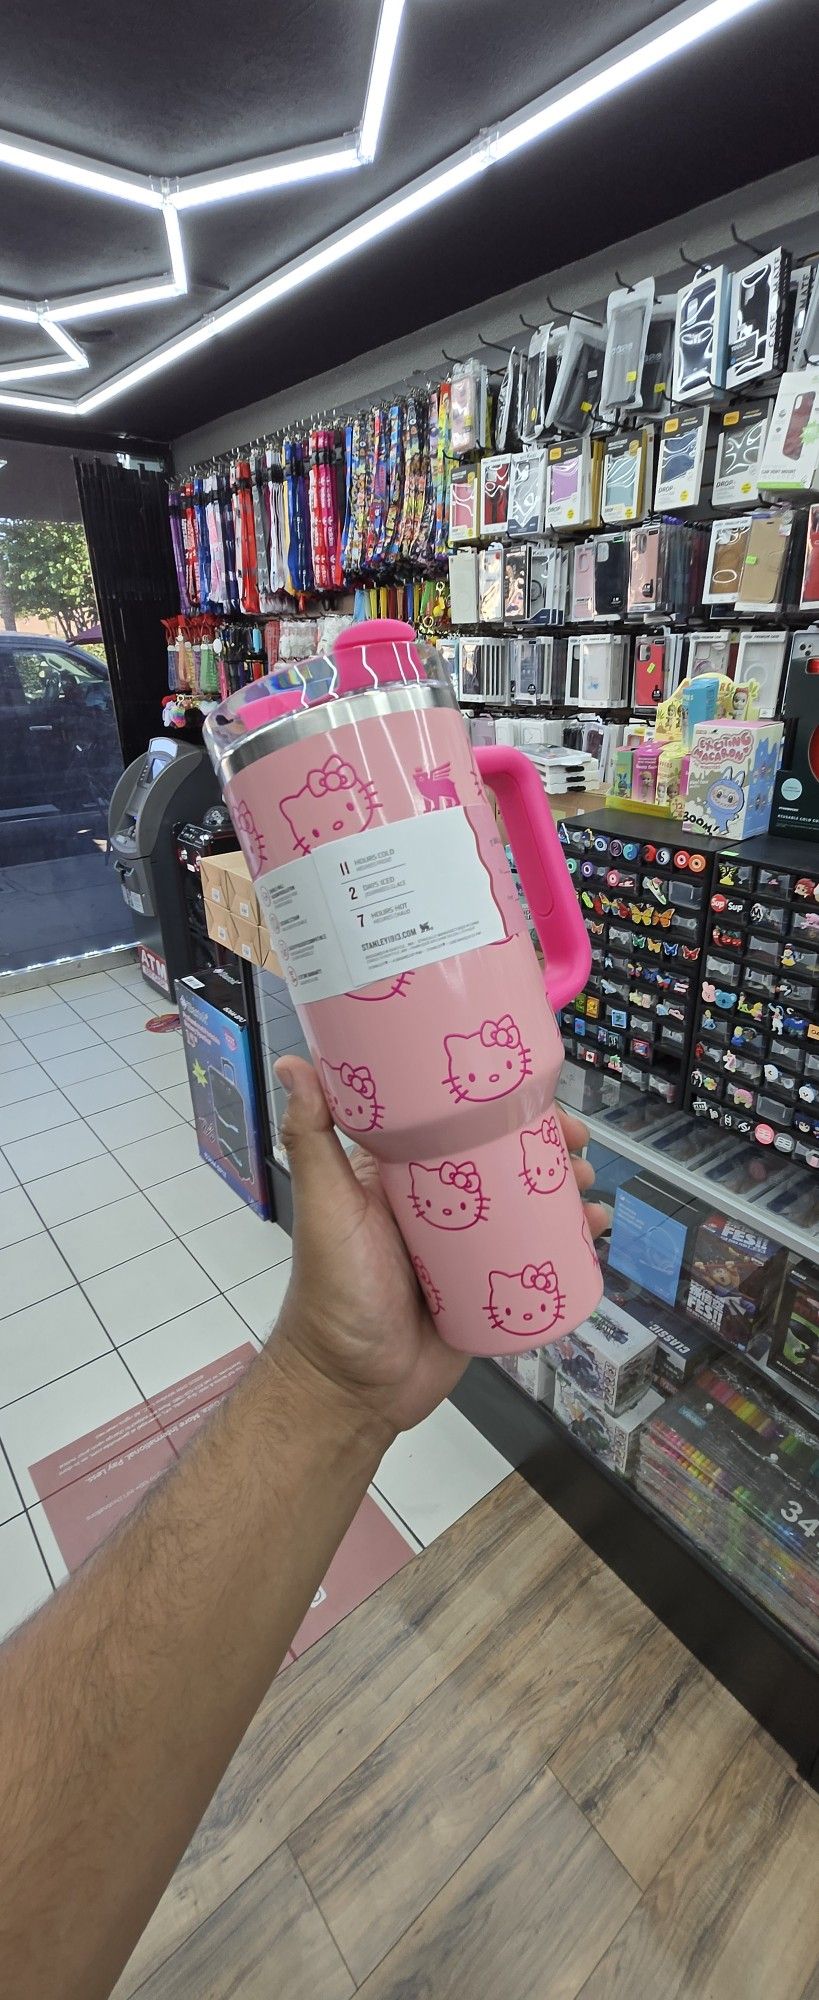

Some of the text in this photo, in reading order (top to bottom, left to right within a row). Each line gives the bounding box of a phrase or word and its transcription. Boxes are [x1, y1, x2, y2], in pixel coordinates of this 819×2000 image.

[348, 887, 358, 900] 2
[728, 902, 743, 912] Sup
[356, 914, 364, 927] 7
[141, 949, 168, 981] ATM
[649, 1322, 692, 1354] CLASSIC
